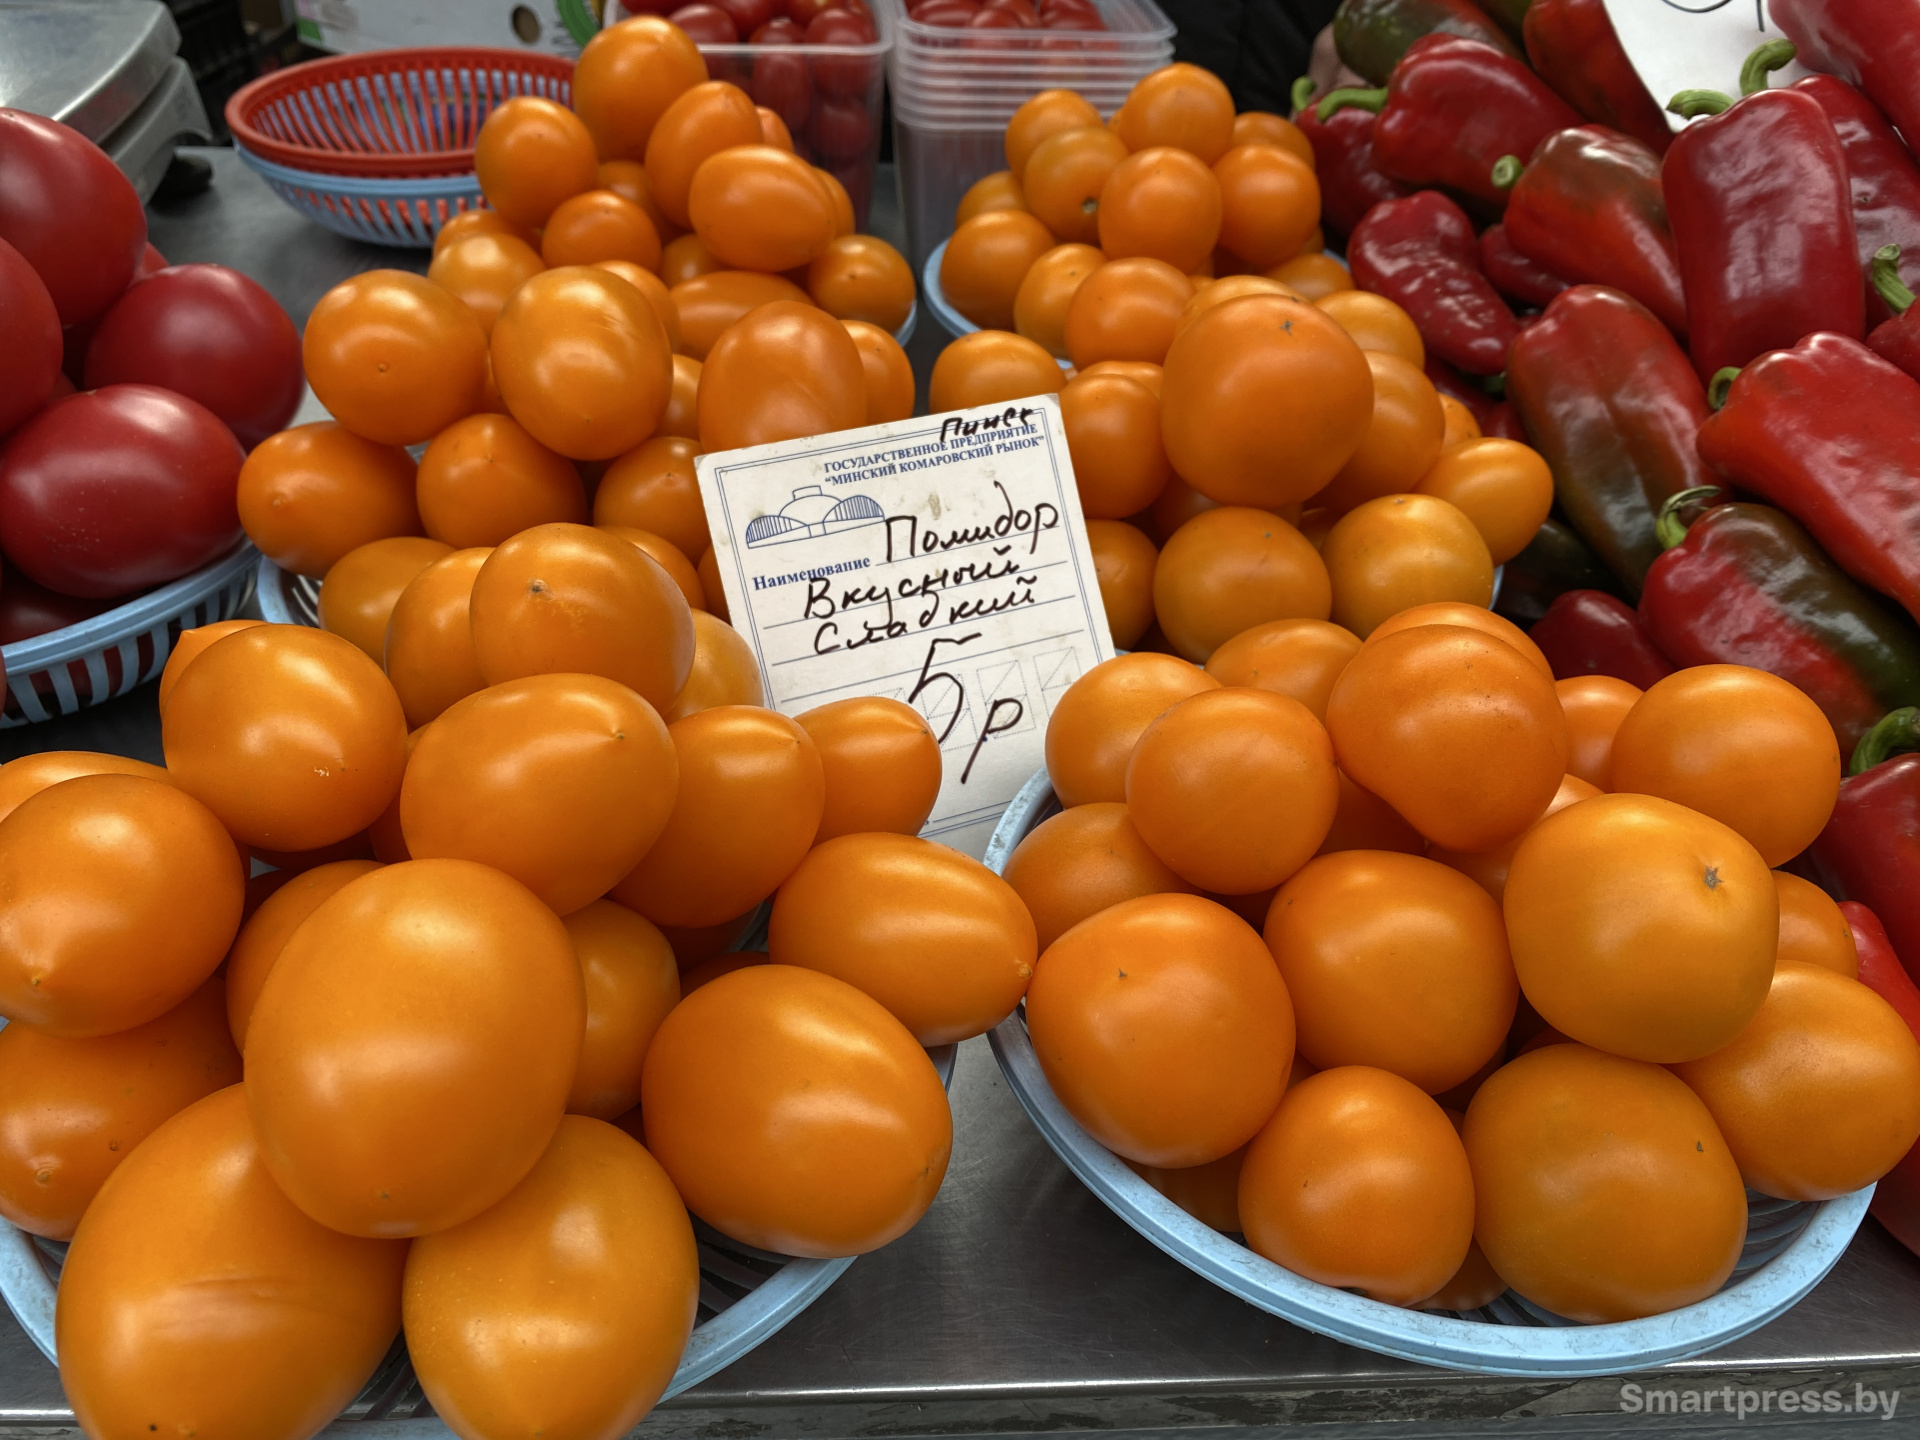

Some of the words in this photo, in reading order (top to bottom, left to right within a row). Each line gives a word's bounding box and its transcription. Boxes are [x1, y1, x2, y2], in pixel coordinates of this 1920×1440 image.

[824, 441, 948, 473] ГОСУДАРСТВЕННОЕ
[950, 423, 1038, 449] ПРЕДПРИЯТИЕ
[898, 443, 993, 474] КОМАРОВСКИЙ
[752, 557, 871, 591] Наименование
[885, 480, 1059, 563] Помидор
[804, 544, 1020, 630] Вкусный
[814, 575, 1038, 655] Сладкий
